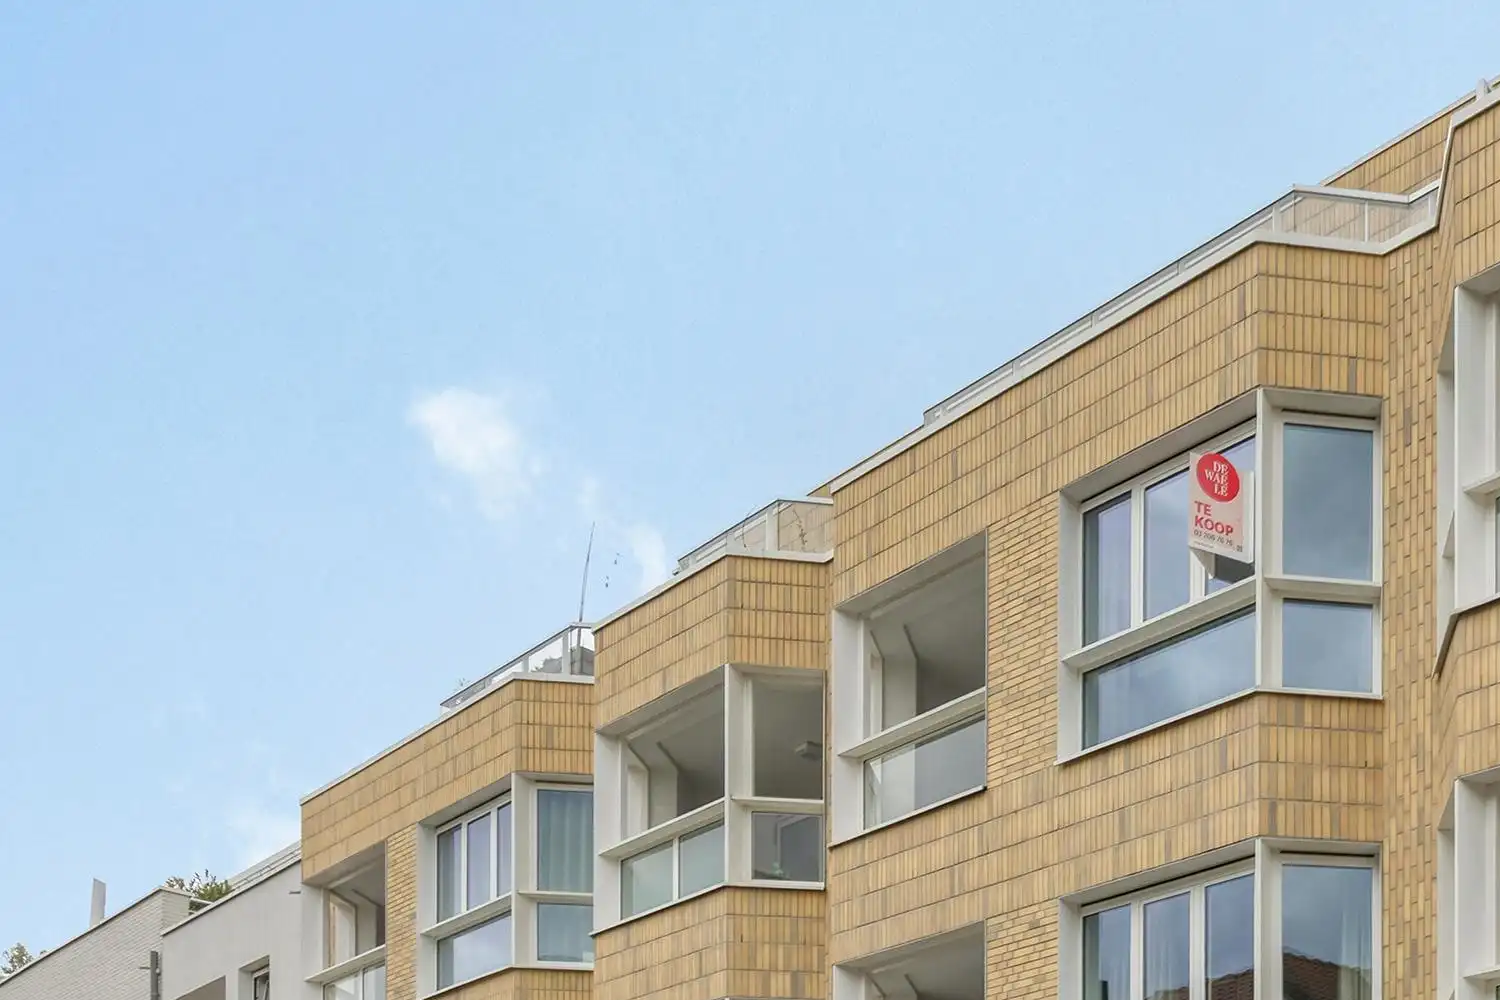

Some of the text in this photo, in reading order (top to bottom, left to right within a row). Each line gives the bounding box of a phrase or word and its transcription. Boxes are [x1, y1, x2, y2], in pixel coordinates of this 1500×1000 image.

[1213, 461, 1229, 475] DE
[1204, 468, 1229, 486] WAE
[1213, 483, 1229, 497] LE
[1194, 500, 1212, 517] TE
[1194, 515, 1234, 536] KOOP
